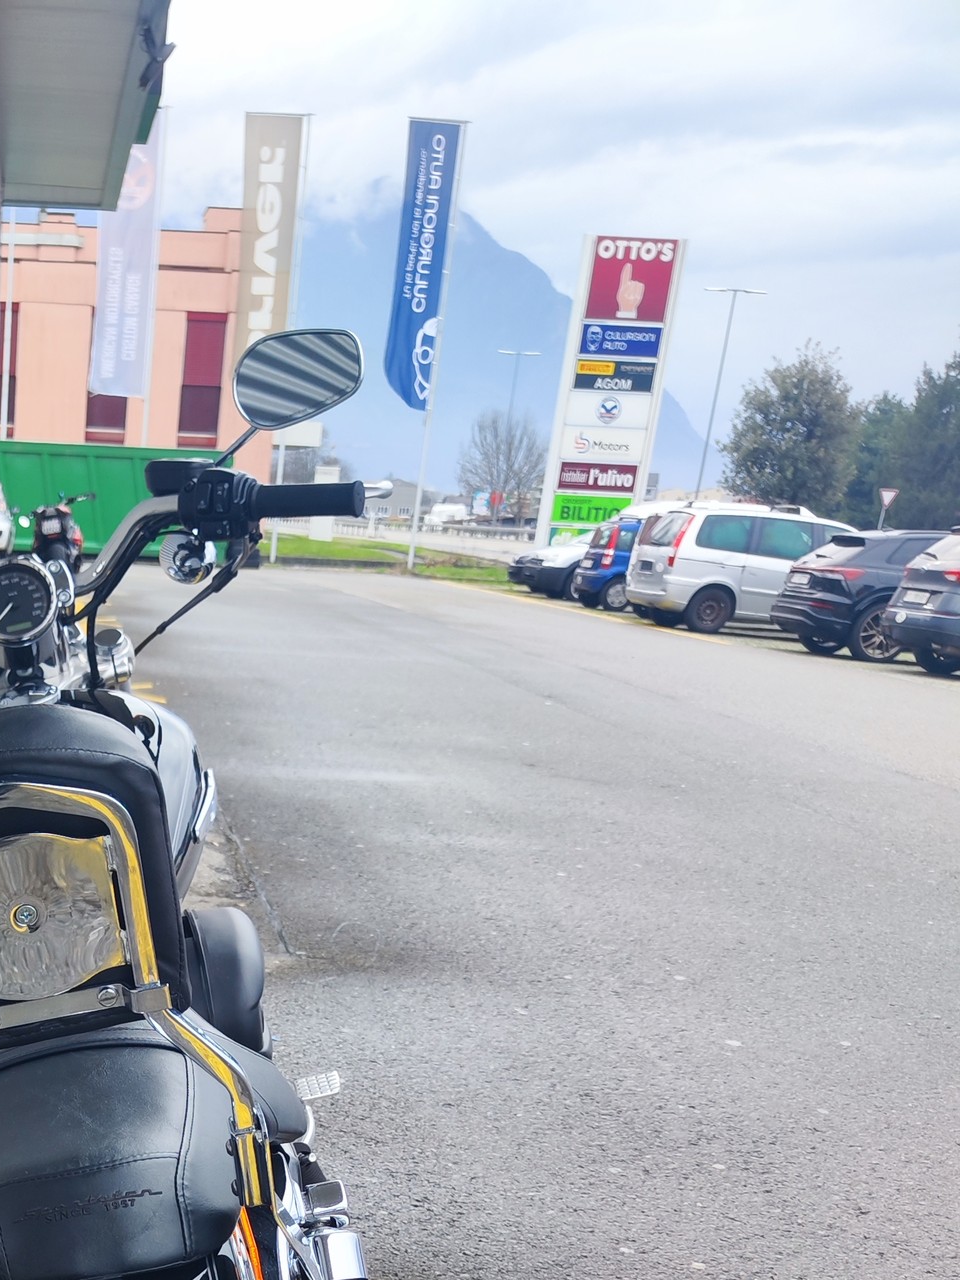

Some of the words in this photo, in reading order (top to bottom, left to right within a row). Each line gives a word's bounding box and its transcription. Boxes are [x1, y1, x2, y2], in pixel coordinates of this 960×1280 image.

[597, 239, 674, 262] OTTO'S
[593, 377, 633, 391] AGOM
[591, 440, 630, 452] Motors
[44, 1208, 91, 1225] SINCE
[104, 1199, 136, 1212] 1957
